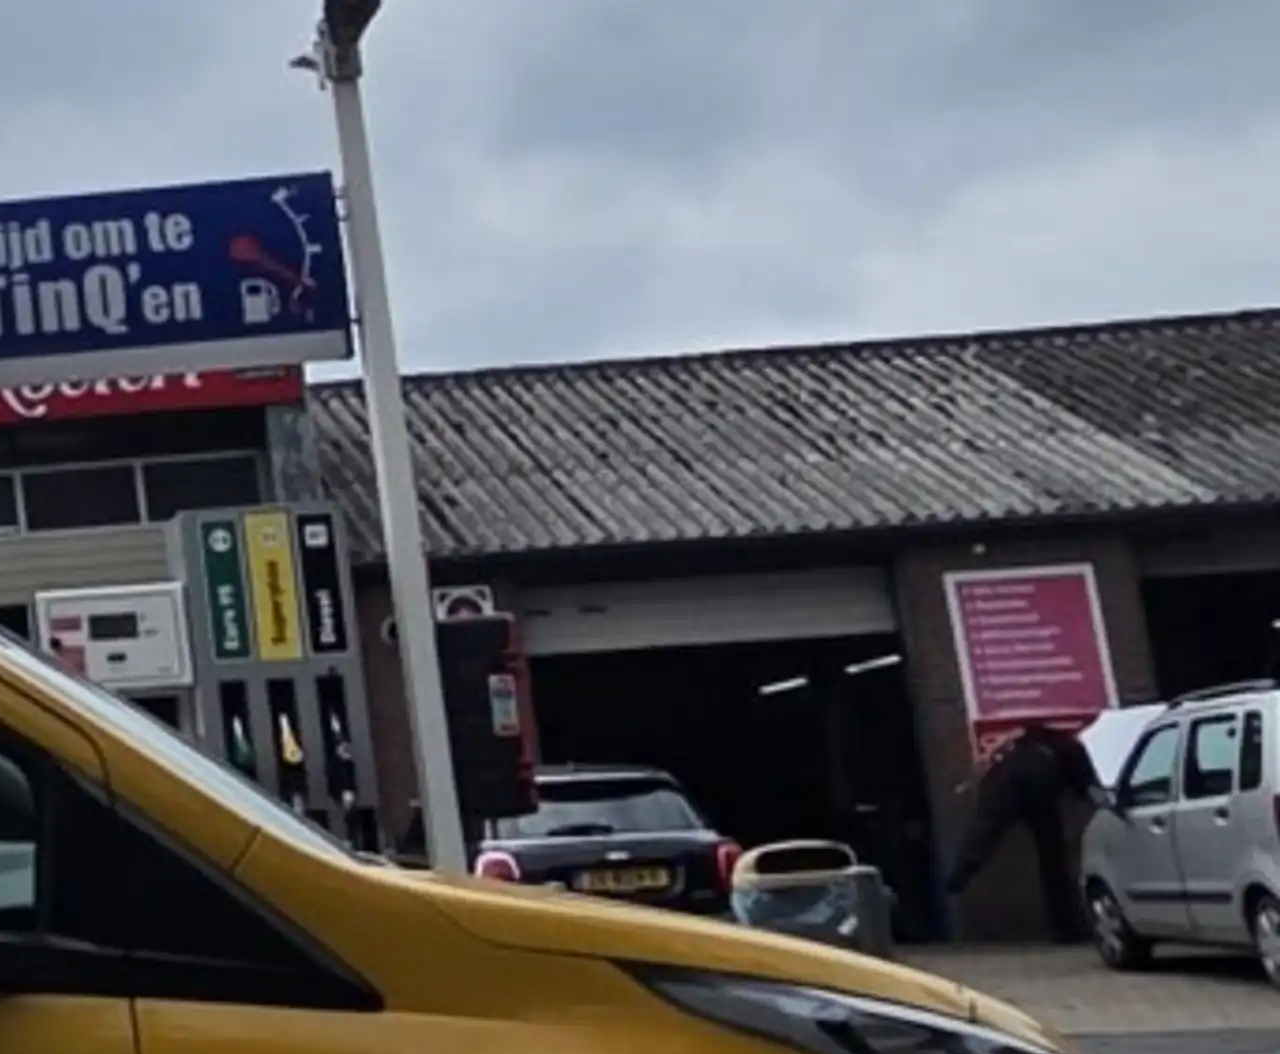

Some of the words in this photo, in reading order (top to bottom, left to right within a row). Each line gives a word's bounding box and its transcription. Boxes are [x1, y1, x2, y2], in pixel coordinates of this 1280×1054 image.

[62, 217, 138, 261] om
[143, 211, 194, 253] te
[222, 608, 240, 650] Euro
[315, 587, 337, 644] Diesel
